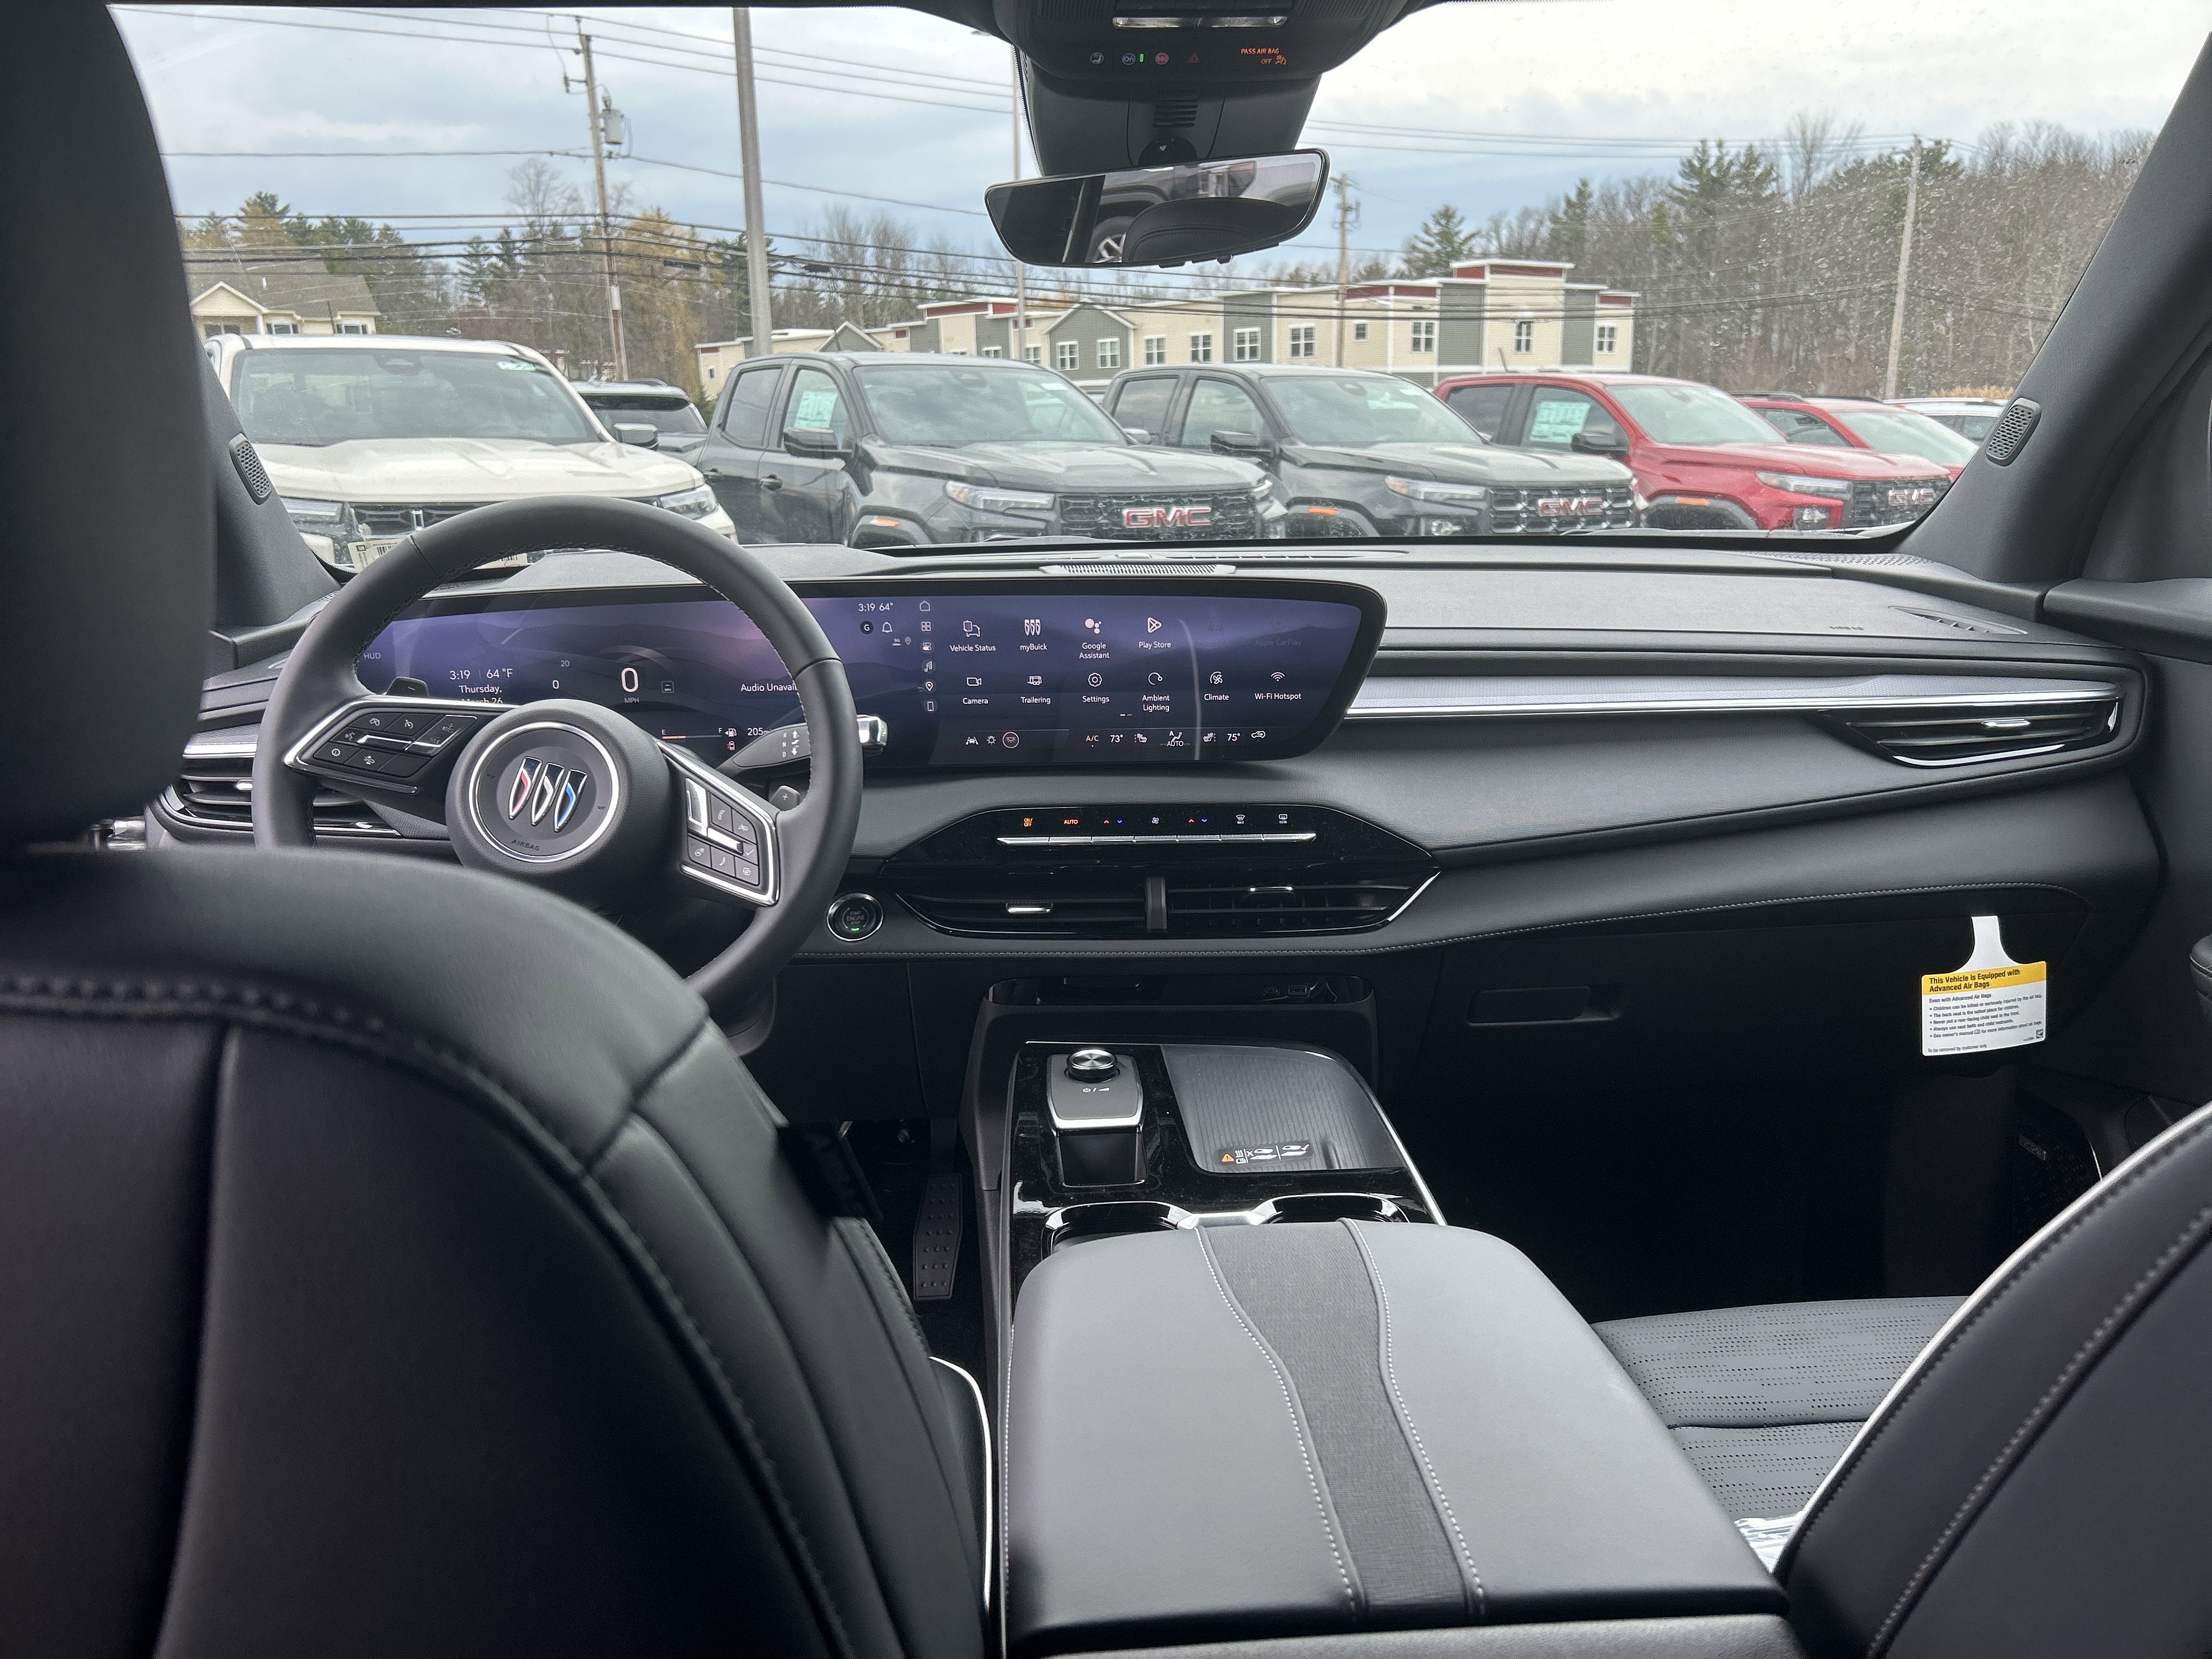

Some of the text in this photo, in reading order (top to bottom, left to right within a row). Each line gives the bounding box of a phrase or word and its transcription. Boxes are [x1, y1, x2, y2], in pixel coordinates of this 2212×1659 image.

[1888, 488, 1934, 506] GMC
[1538, 497, 1603, 517] GMC
[1122, 506, 1211, 528] GMC
[859, 602, 893, 612] 3:19 64°
[1082, 642, 1106, 651] Google
[1139, 641, 1152, 650] Play
[1276, 639, 1302, 647] CarPlay
[1020, 644, 1047, 652] myBuick
[450, 670, 471, 680] 3:19
[486, 669, 500, 678] 64
[552, 680, 560, 689] 0
[620, 667, 639, 693] 0
[459, 684, 503, 695] Thursday,
[1021, 697, 1051, 706] Trailering
[1082, 696, 1109, 704] Settings
[1274, 693, 1301, 701] Hotspot
[1143, 703, 1170, 712] Lighting
[1110, 735, 1124, 743] 73°
[1227, 733, 1241, 742] 75°
[511, 839, 540, 851] AIRBAG
[1945, 975, 1968, 983] Vehicle
[1977, 970, 2006, 980] Equipped
[1929, 983, 1962, 992] Advanced
